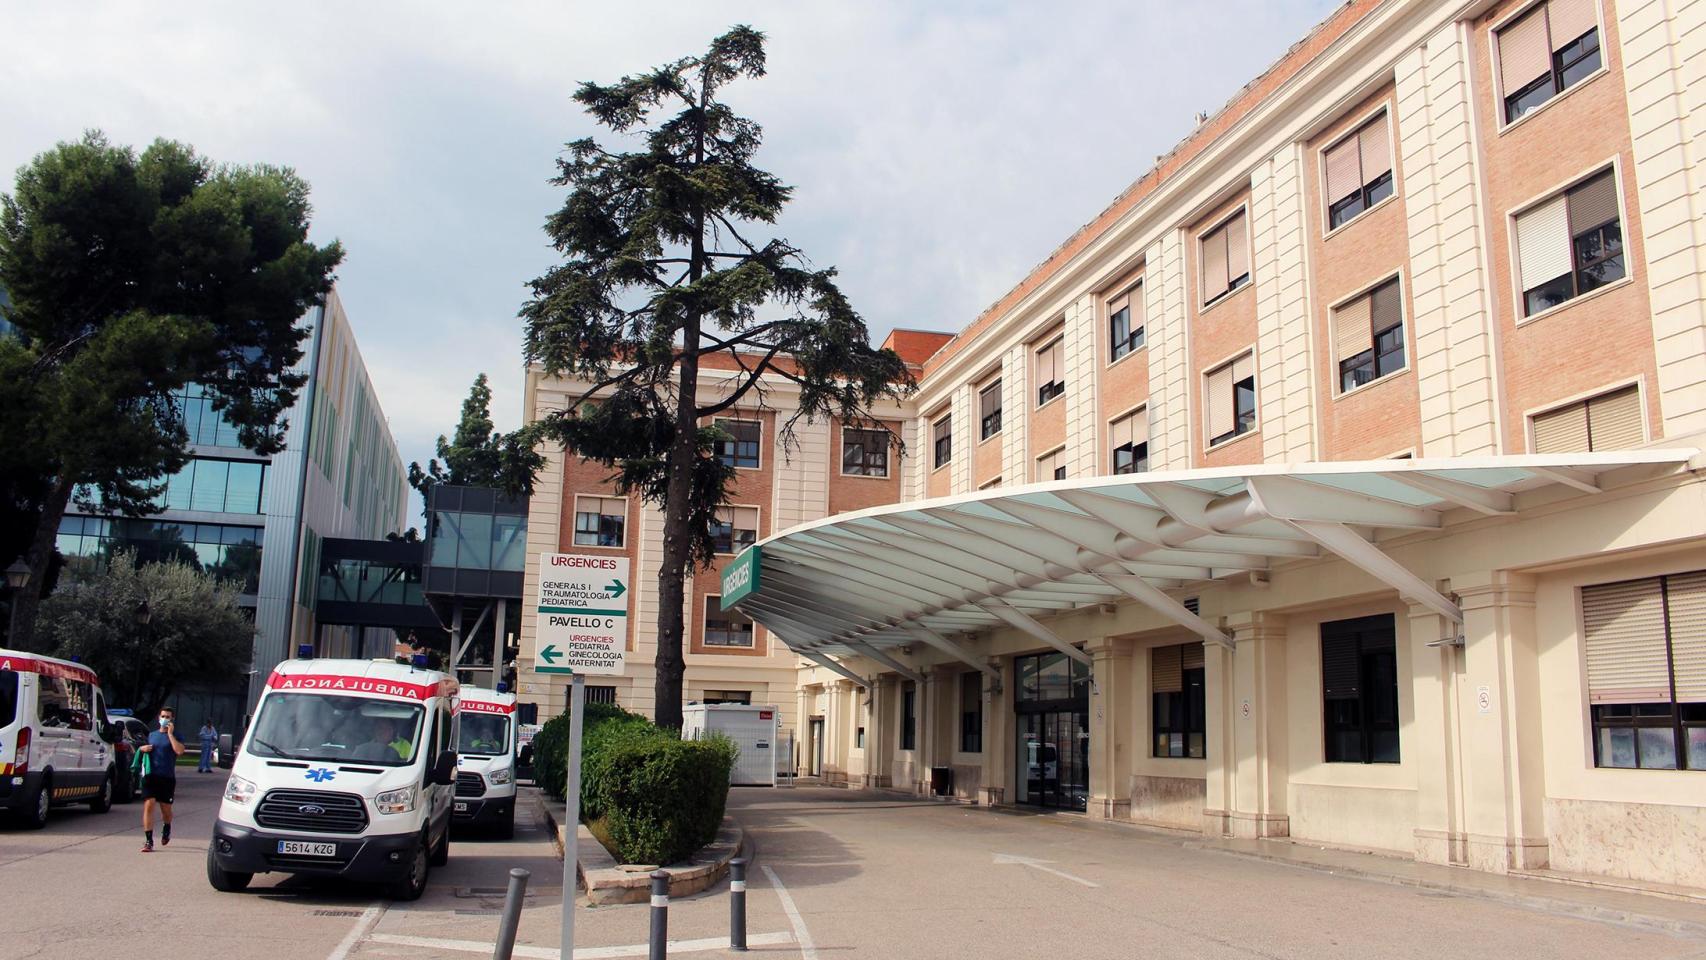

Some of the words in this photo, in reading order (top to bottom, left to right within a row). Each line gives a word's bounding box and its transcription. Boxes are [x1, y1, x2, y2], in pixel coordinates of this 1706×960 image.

[551, 556, 617, 570] URGENCIES
[542, 581, 586, 591] GENERALS
[543, 589, 611, 600] TRAUMATOLOGIA
[541, 598, 588, 607] PEDIATRICA
[549, 616, 601, 628] PAVELLO
[605, 619, 614, 629] C
[569, 634, 614, 643] URGENCIES
[569, 642, 610, 651] PEDIATRIA
[568, 651, 623, 660] GINECOLOGIA
[568, 659, 616, 668] MATERNITAT
[285, 843, 310, 853] 5614
[314, 844, 333, 854] KZG
